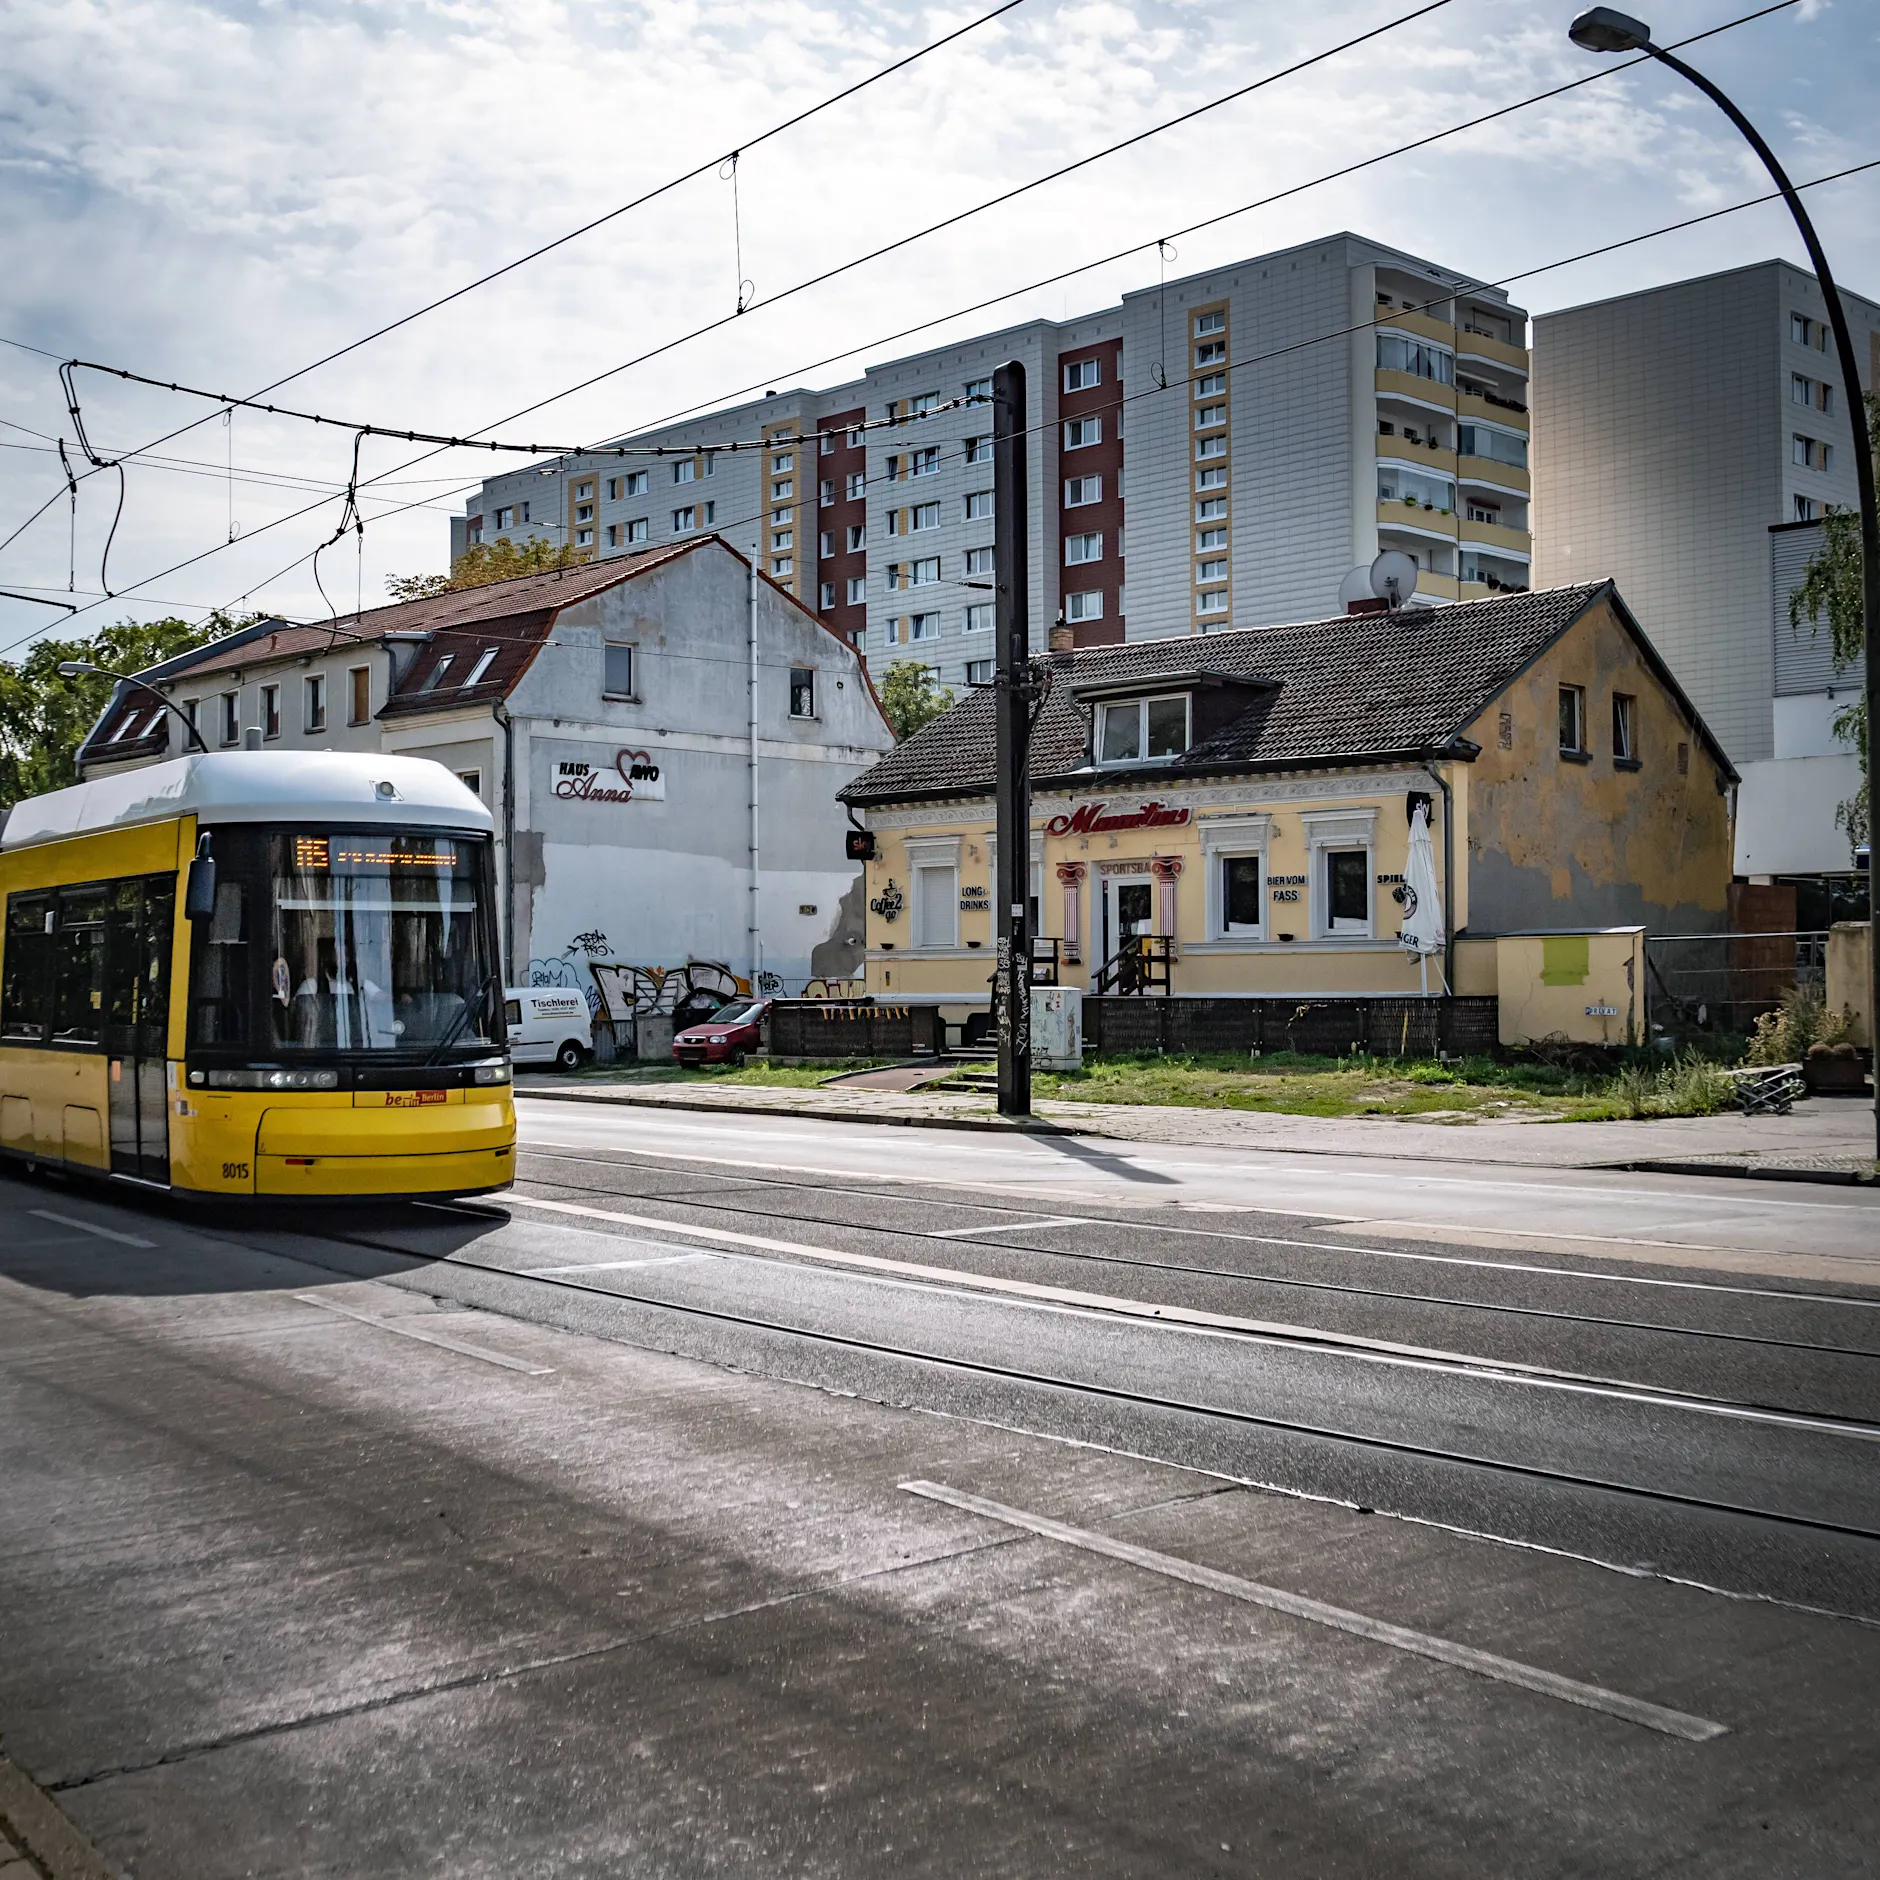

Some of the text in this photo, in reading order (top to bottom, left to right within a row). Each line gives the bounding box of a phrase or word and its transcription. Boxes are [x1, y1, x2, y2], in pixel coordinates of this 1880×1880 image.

[559, 762, 590, 776] HAUS
[556, 772, 632, 803] Anna
[1415, 799, 1430, 819] sky
[1100, 862, 1152, 875] SPORTSBA
[1267, 875, 1305, 886] BIER VOM
[961, 886, 983, 897] LONG
[1273, 890, 1298, 902] FASS
[870, 893, 902, 915] Coffee 2
[960, 900, 989, 910] DRINKS
[885, 910, 897, 924] go
[531, 998, 579, 1008] Tischlerei
[385, 1092, 446, 1106] be Berlin
[222, 1163, 249, 1179] 8015
